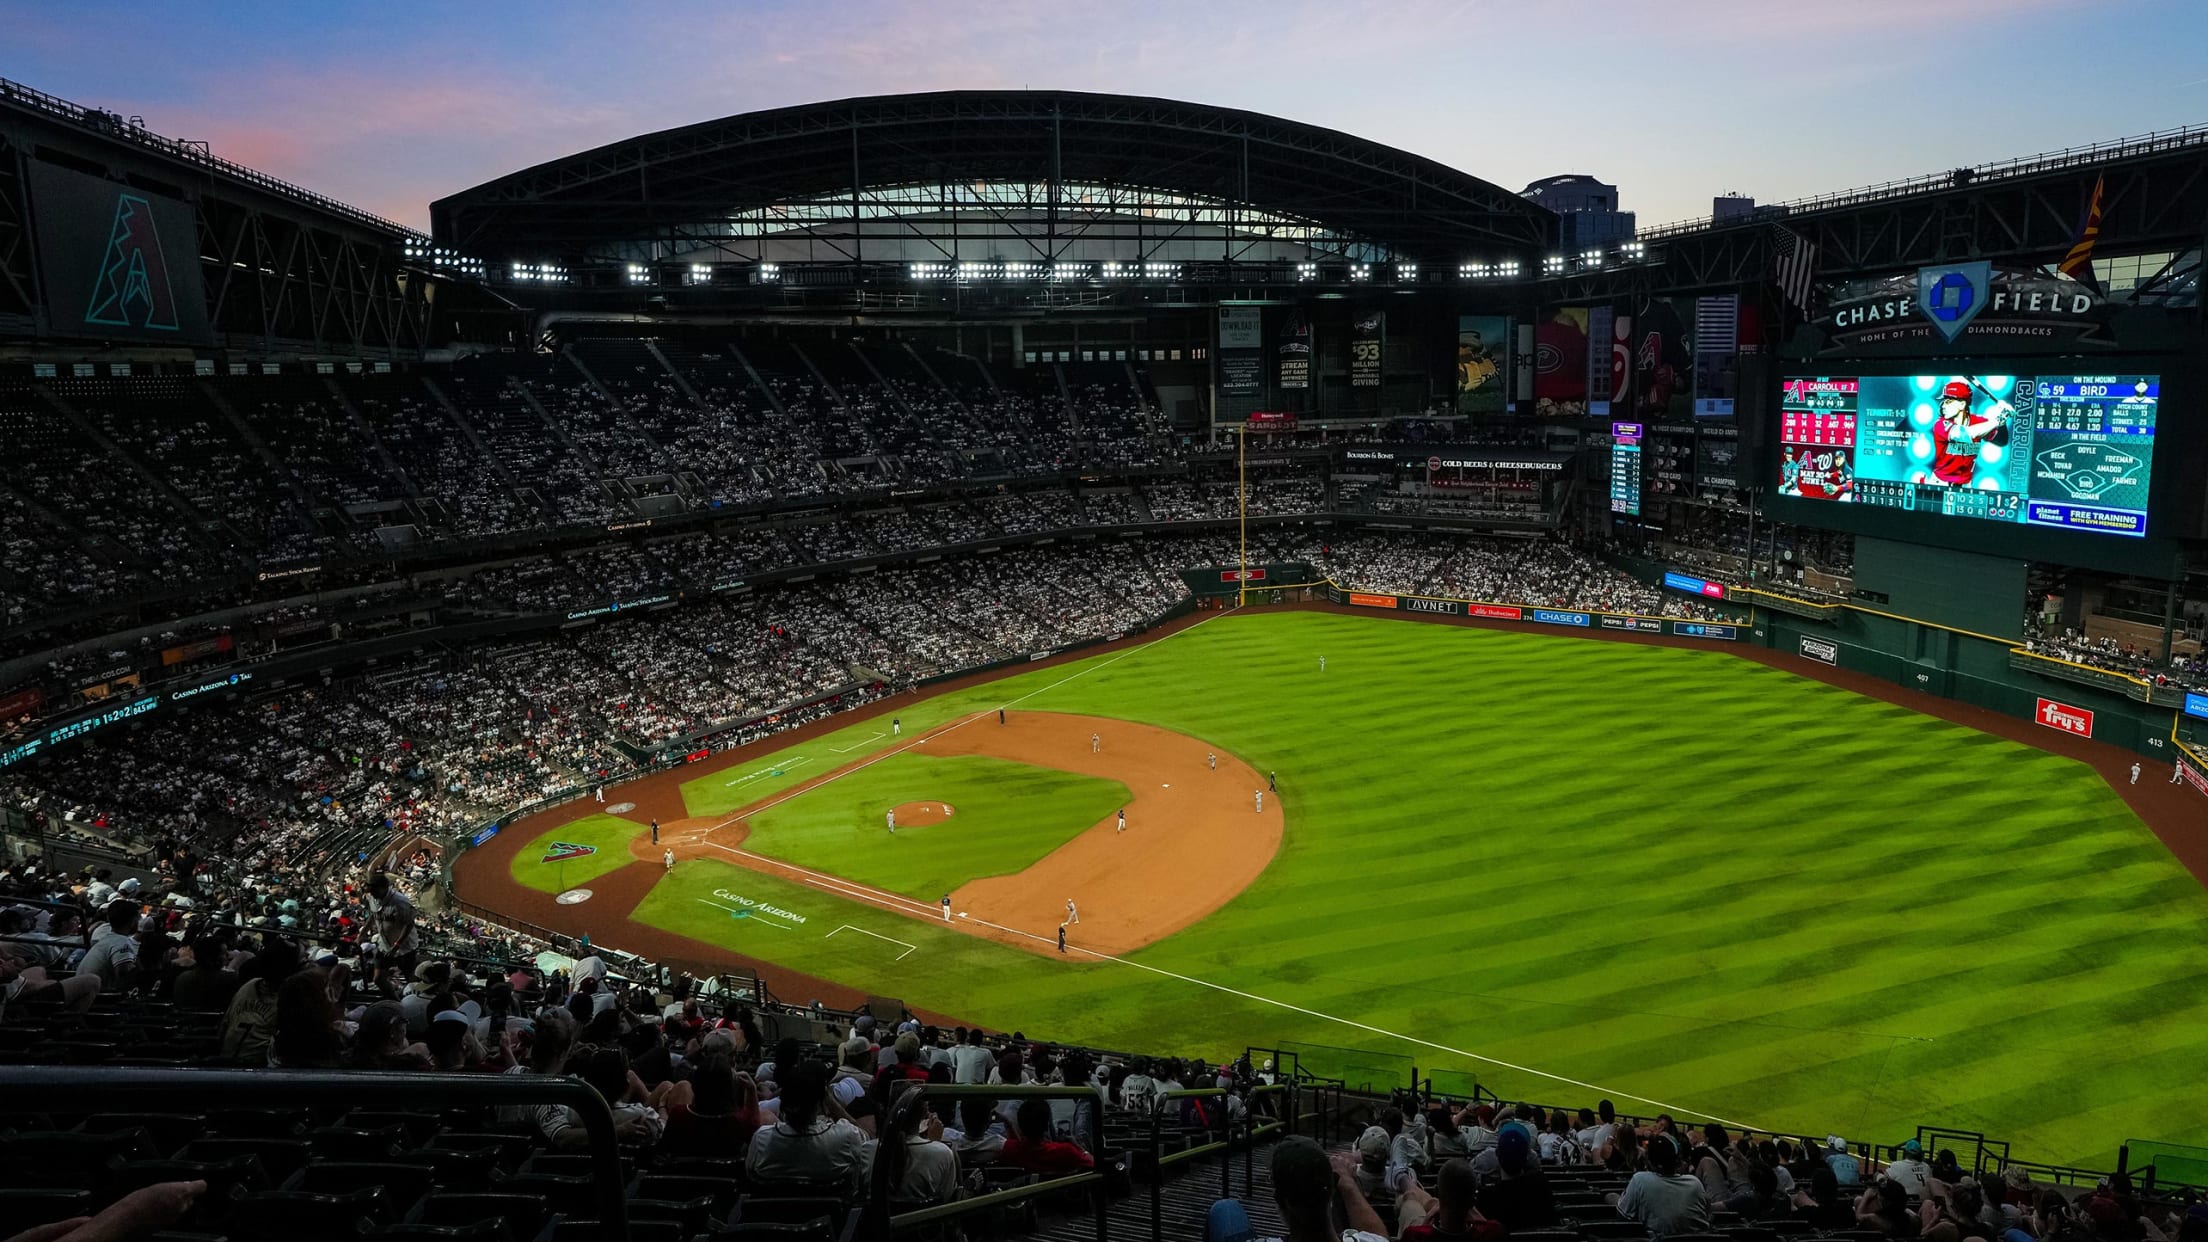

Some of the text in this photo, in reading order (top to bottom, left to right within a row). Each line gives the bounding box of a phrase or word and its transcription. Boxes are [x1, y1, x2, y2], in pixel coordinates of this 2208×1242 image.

[1835, 291, 2092, 327] CHASE FIELD
[1860, 325, 2054, 343] HOME OF THE DIAMONDBACKS
[2073, 376, 2082, 384] ON
[2095, 376, 2117, 384] MOUND
[1808, 383, 1838, 391] CARROLL
[2053, 385, 2107, 396] 59 BIRD
[2067, 408, 2081, 416] 27.0
[2087, 409, 2103, 417] 2.00
[2010, 380, 2033, 492] CARROLL
[2078, 446, 2096, 454] DOYLE
[1463, 460, 1488, 468] BEERS
[1495, 461, 1562, 471] CHEESEBURGERS
[2096, 465, 2123, 473] AMADOR
[2079, 480, 2093, 488] BIRD
[1957, 494, 1966, 503] 10
[2010, 496, 2018, 509] 2
[1957, 506, 1966, 515] 13
[2070, 510, 2137, 525] FREE TRAINING
[1413, 599, 1452, 613] AVNET
[1488, 610, 1517, 618] Budweiser
[1540, 612, 1573, 623] CHASE
[1604, 615, 1659, 630] PEPSI PEPSI
[102, 713, 108, 724] 1
[113, 710, 120, 721] 2
[124, 706, 131, 717] 2
[2042, 703, 2086, 732] fry's
[2148, 738, 2163, 747] 413
[1128, 1094, 1143, 1109] 53
